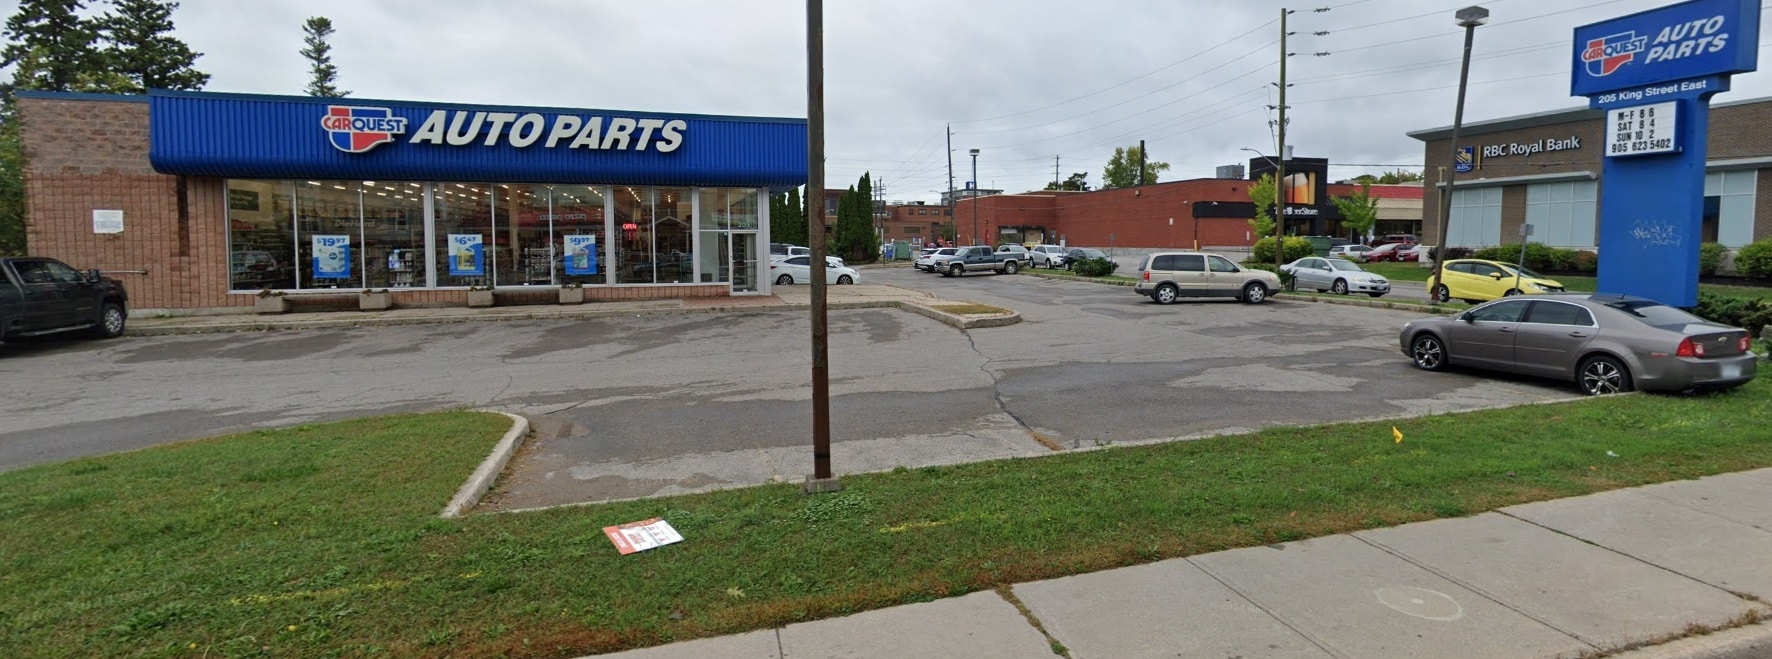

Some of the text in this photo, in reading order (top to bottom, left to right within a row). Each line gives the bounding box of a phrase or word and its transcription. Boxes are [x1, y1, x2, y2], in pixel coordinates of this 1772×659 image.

[1653, 15, 1725, 44] AUTO
[1583, 38, 1646, 61] CARQUEST
[1645, 33, 1729, 64] PARTS
[1598, 80, 1707, 104] 205 King Street East
[321, 116, 404, 132] CARQUEST
[1617, 117, 1655, 132] SAT 8 4
[1618, 107, 1655, 121] M-F 8 6
[409, 110, 687, 153] AUTO PARTS
[1617, 129, 1655, 142] SUN 10 2
[1483, 135, 1580, 157] RBC Royal Bank
[1611, 138, 1671, 153] 905 623 5402
